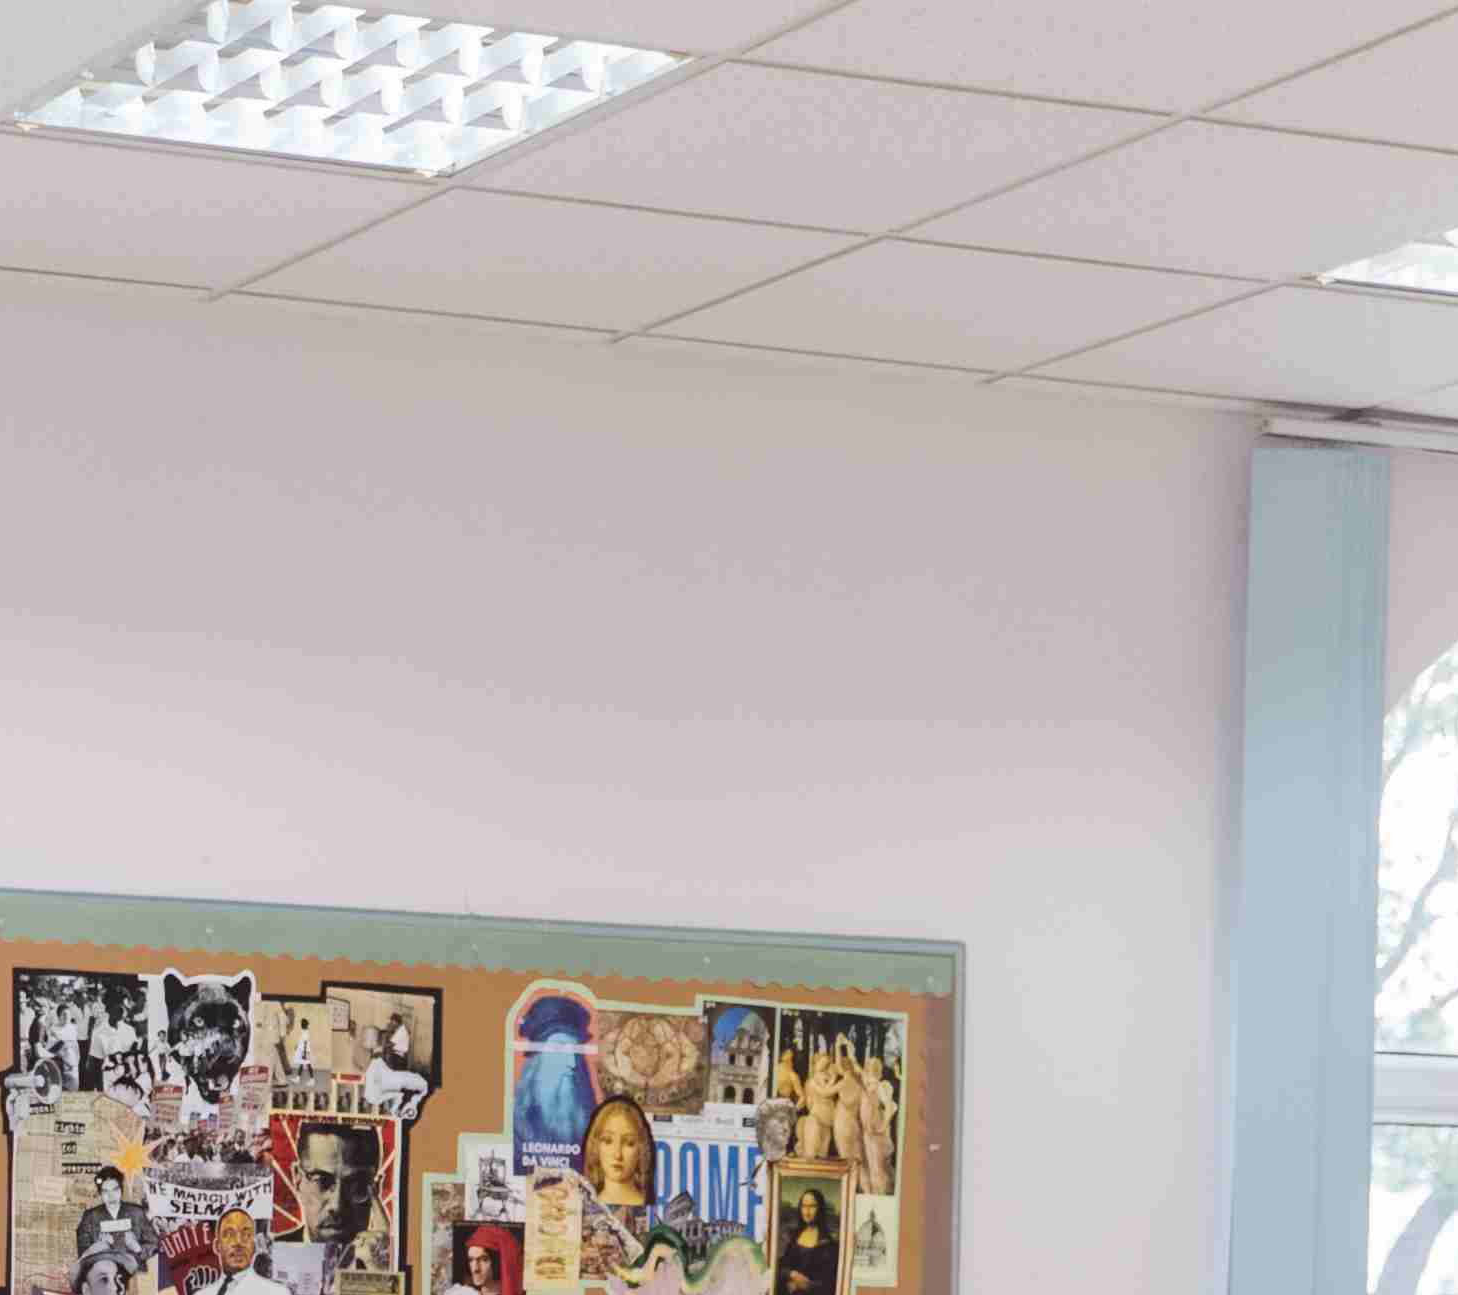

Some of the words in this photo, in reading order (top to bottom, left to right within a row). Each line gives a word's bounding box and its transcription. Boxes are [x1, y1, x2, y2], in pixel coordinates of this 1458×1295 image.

[522, 1142, 581, 1155] LEONARDO
[522, 1156, 538, 1167] DA
[540, 1156, 570, 1169] VINCI
[174, 1187, 229, 1204] MARCH
[235, 1182, 272, 1201] WITH
